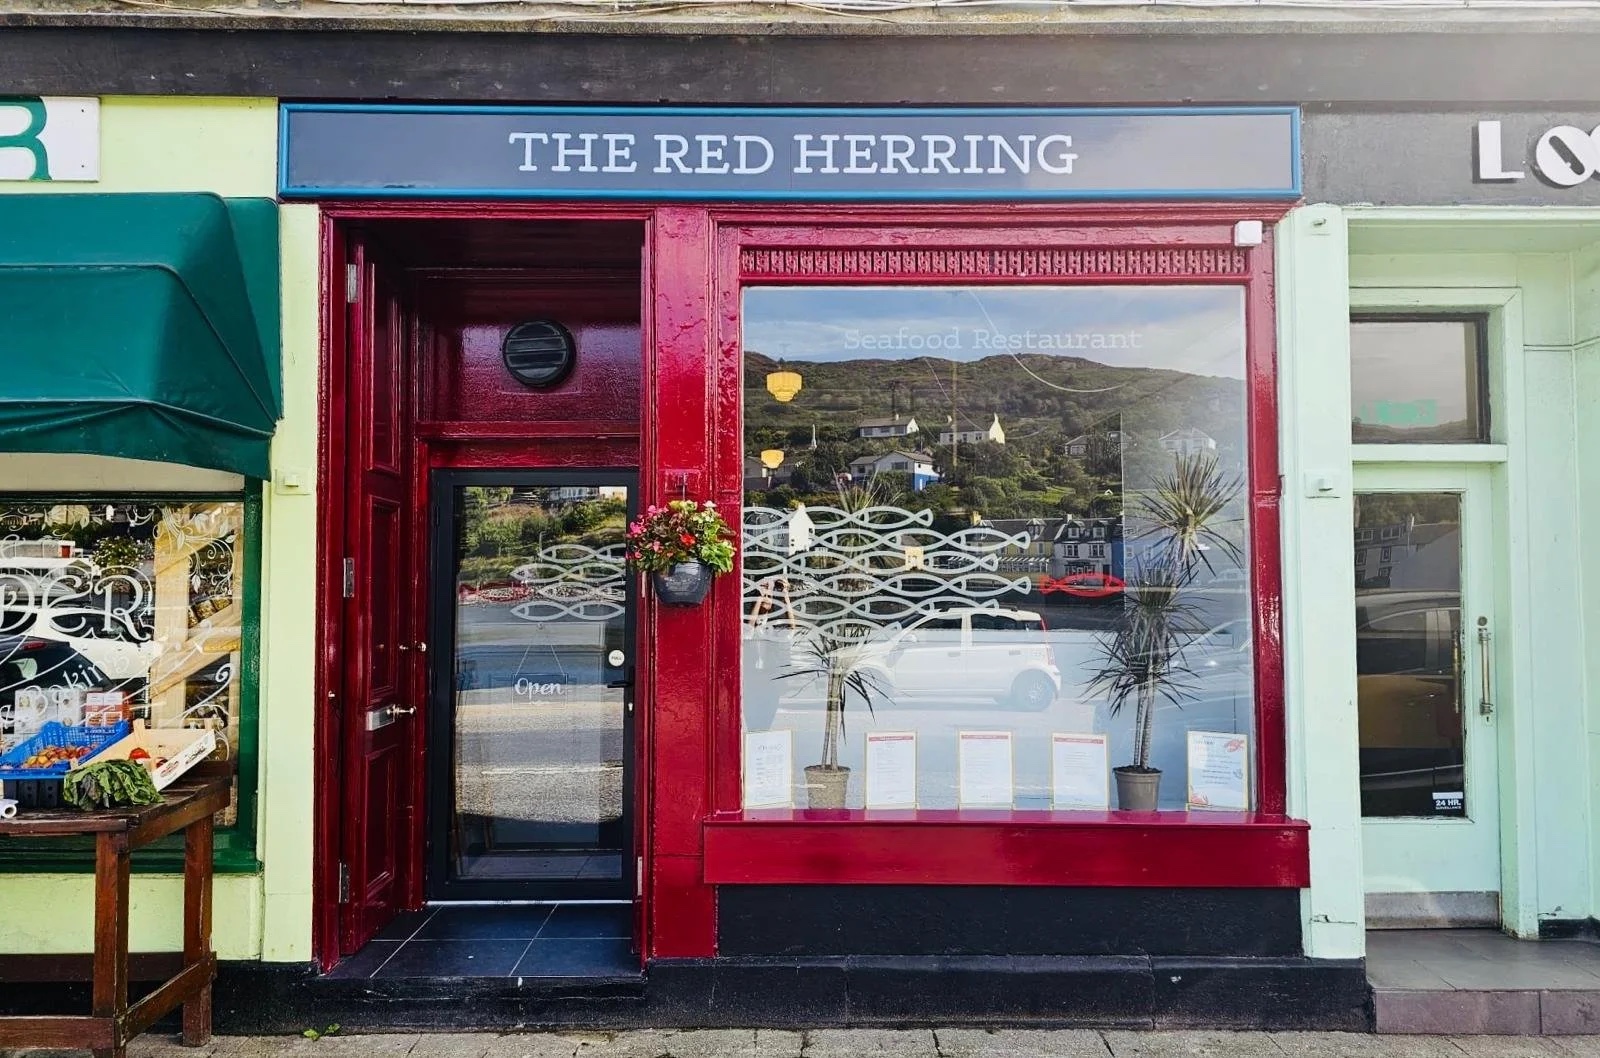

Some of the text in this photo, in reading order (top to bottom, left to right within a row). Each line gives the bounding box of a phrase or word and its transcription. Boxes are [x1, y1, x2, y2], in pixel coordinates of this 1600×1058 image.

[508, 132, 1079, 174] THE RED HERRING
[1478, 120, 1600, 186] LO
[844, 327, 1143, 350] Seafood Restaurant
[514, 677, 565, 700] Open
